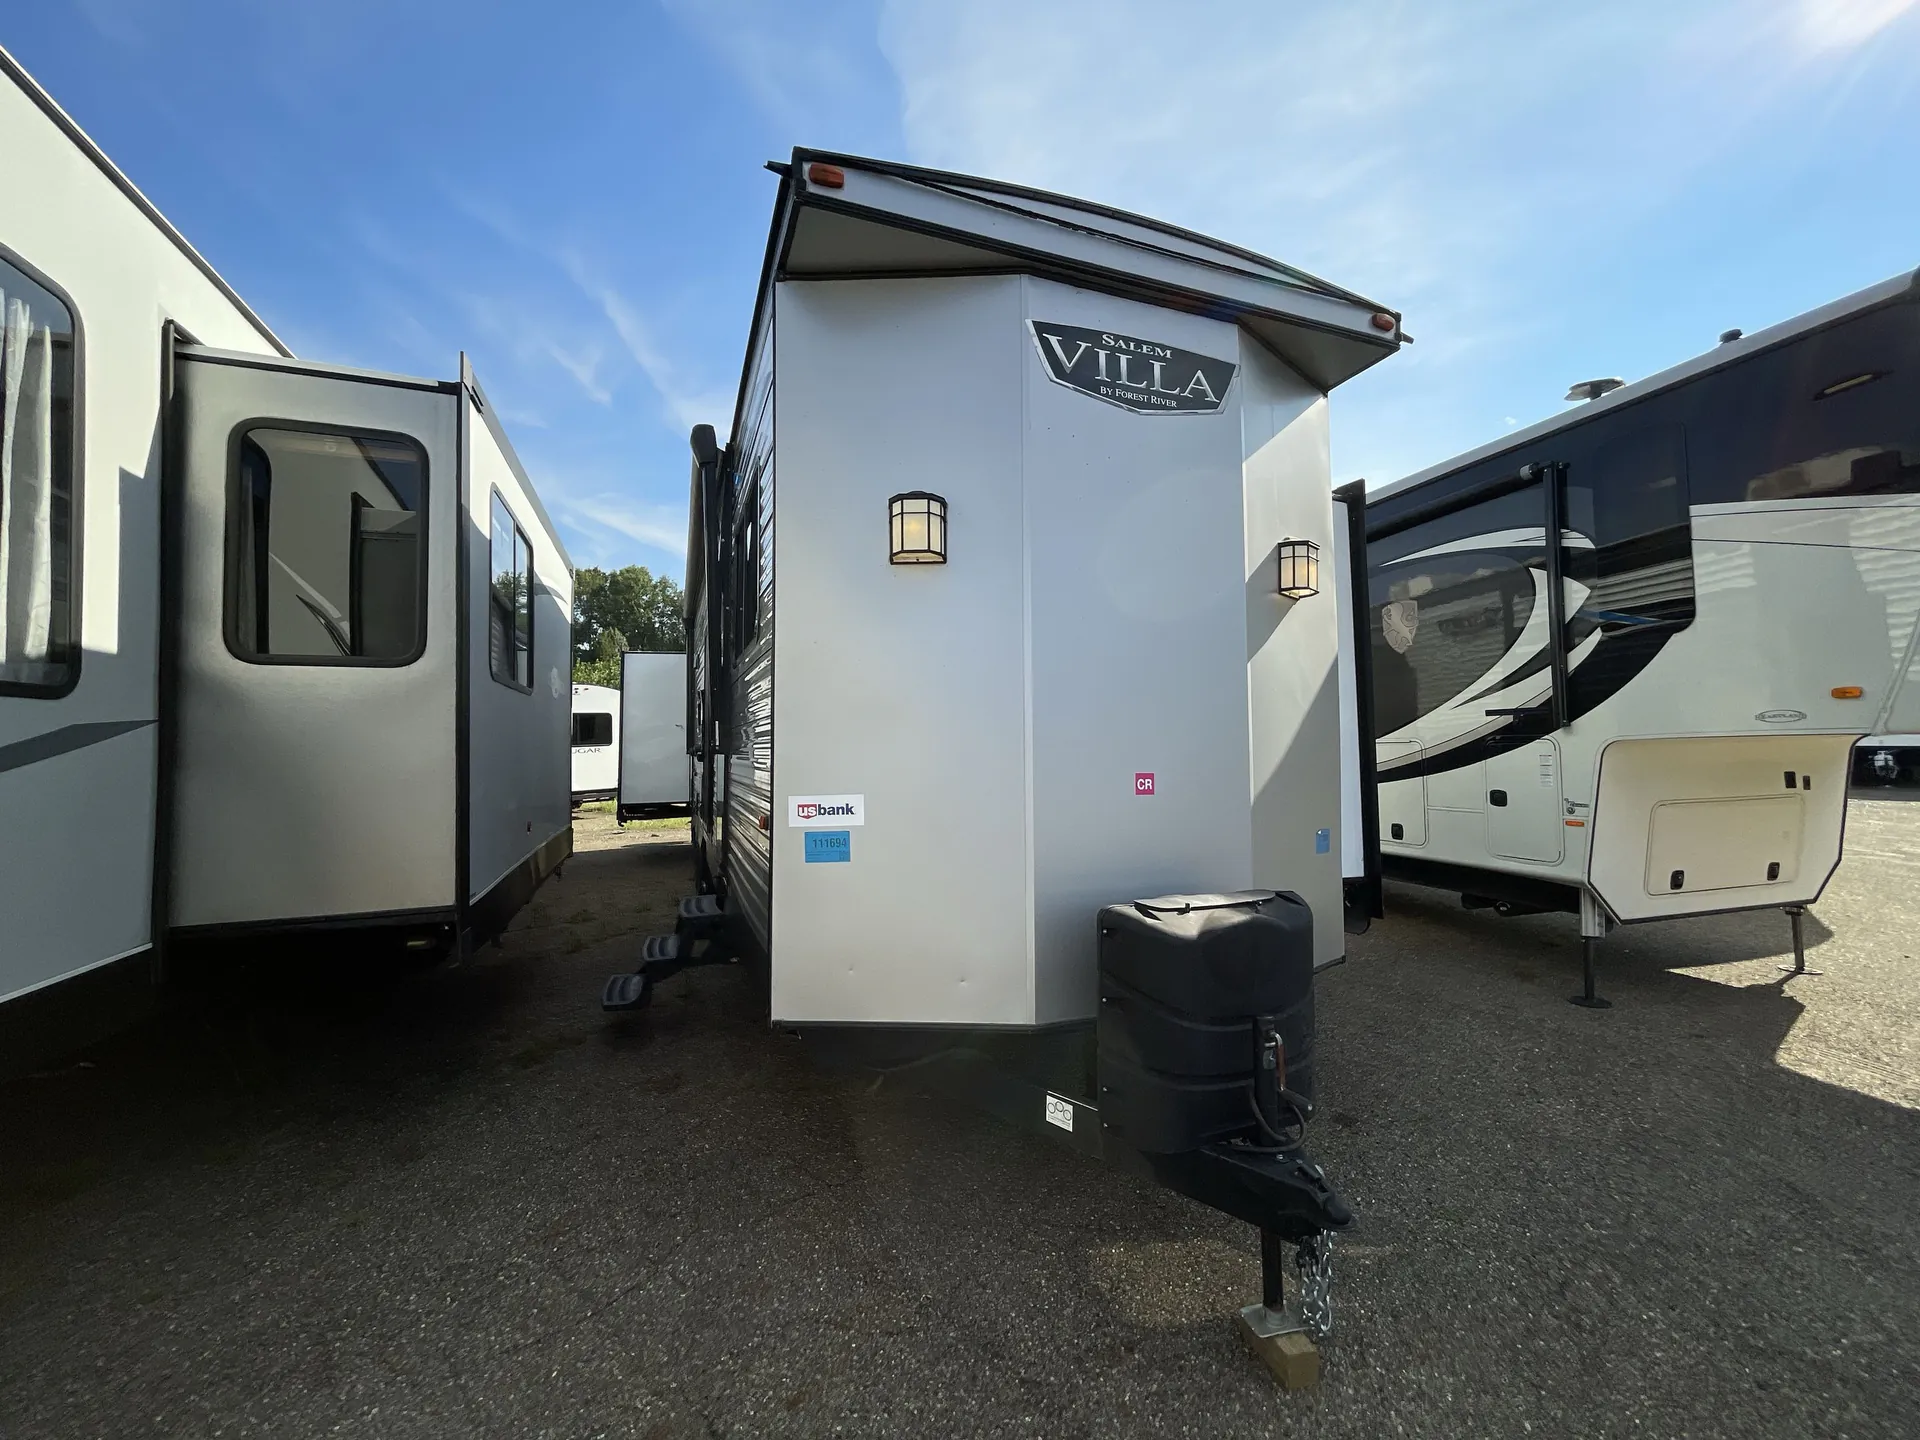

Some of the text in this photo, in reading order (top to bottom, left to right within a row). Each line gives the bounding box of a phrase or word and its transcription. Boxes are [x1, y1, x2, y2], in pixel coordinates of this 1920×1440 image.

[1102, 334, 1172, 359] SALEM
[1042, 333, 1220, 403] VILLA
[1100, 386, 1177, 408] BY FOREST RIVER
[1137, 778, 1153, 790] CR
[812, 837, 847, 848] 111694
